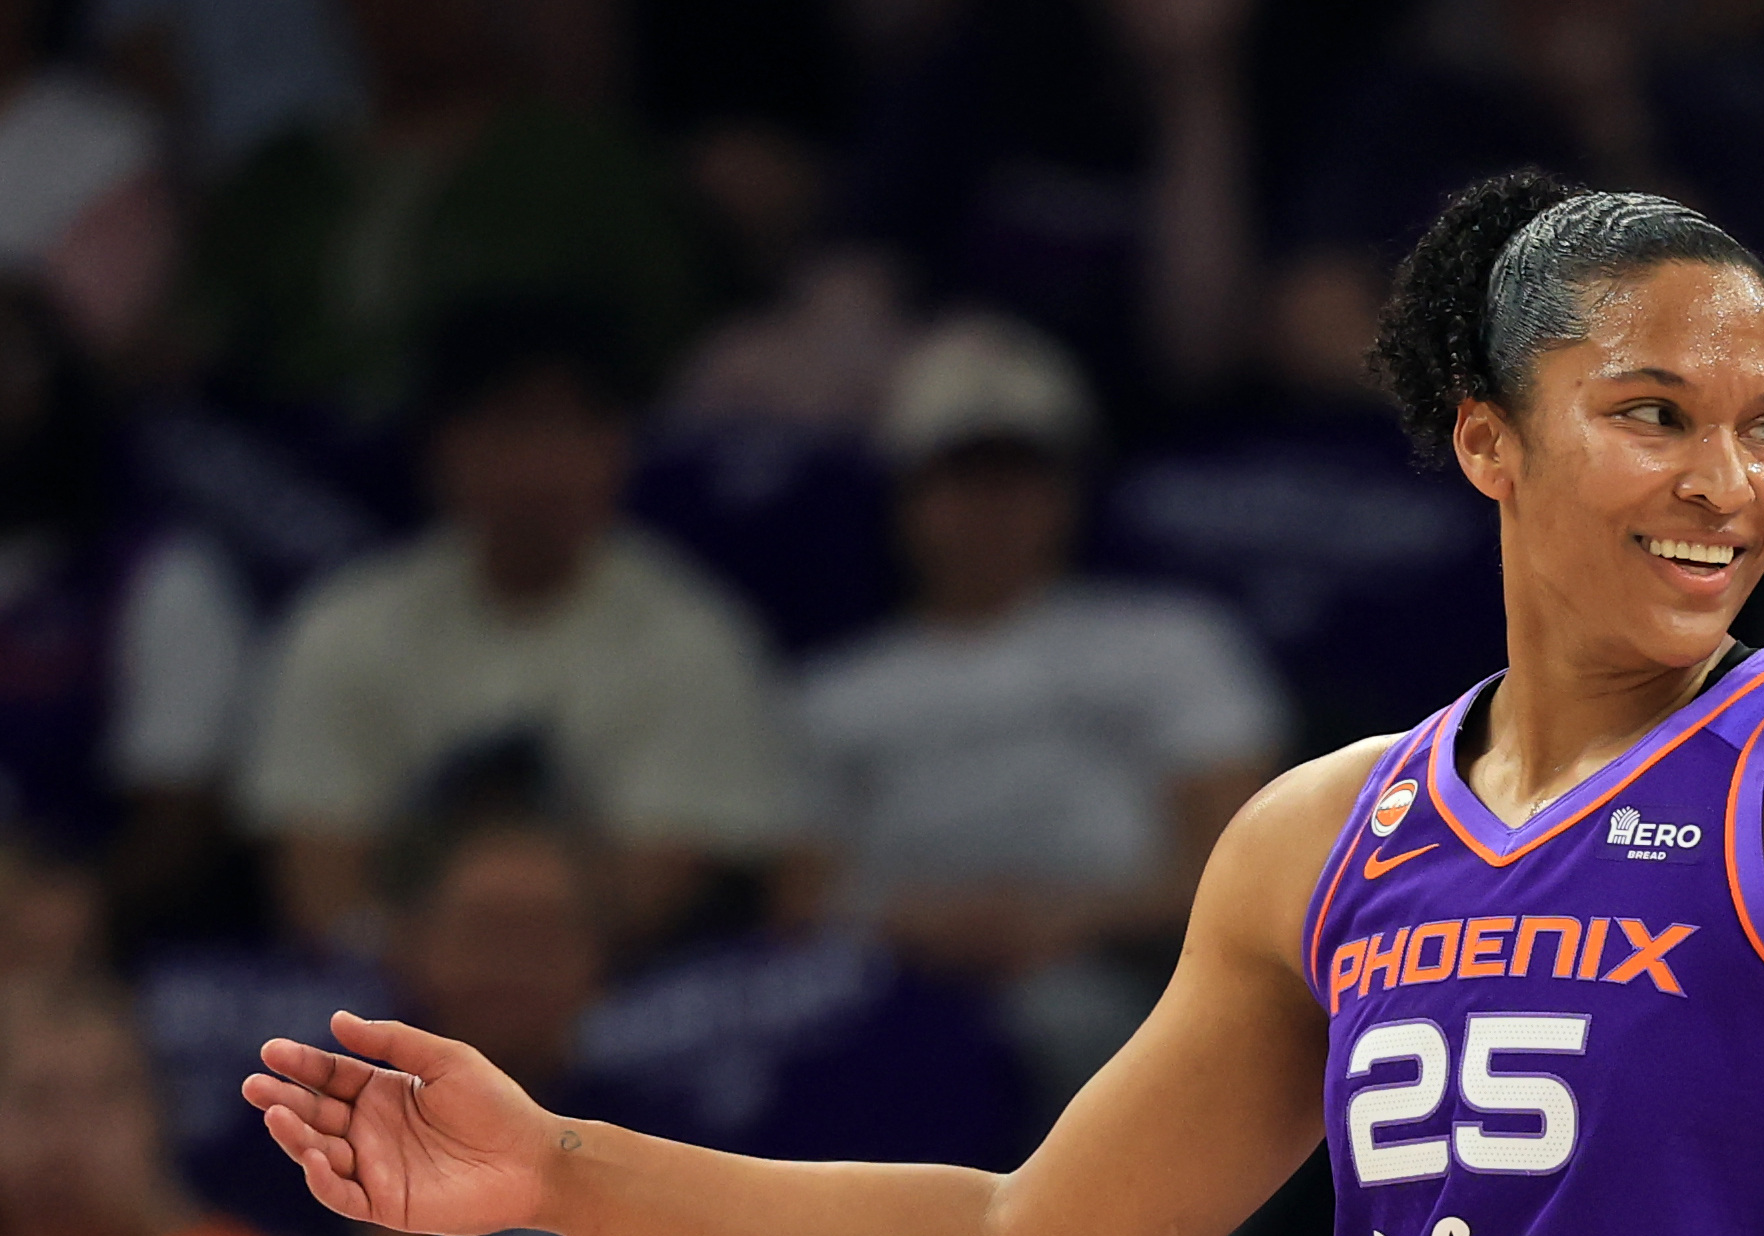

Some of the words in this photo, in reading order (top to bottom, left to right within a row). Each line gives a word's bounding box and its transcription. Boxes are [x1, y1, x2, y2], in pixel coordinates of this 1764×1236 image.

[1606, 808, 1702, 849] HERO
[1626, 850, 1667, 860] BREAD
[1330, 914, 1702, 1018] PHOENIX
[1346, 1011, 1592, 1188] 25
